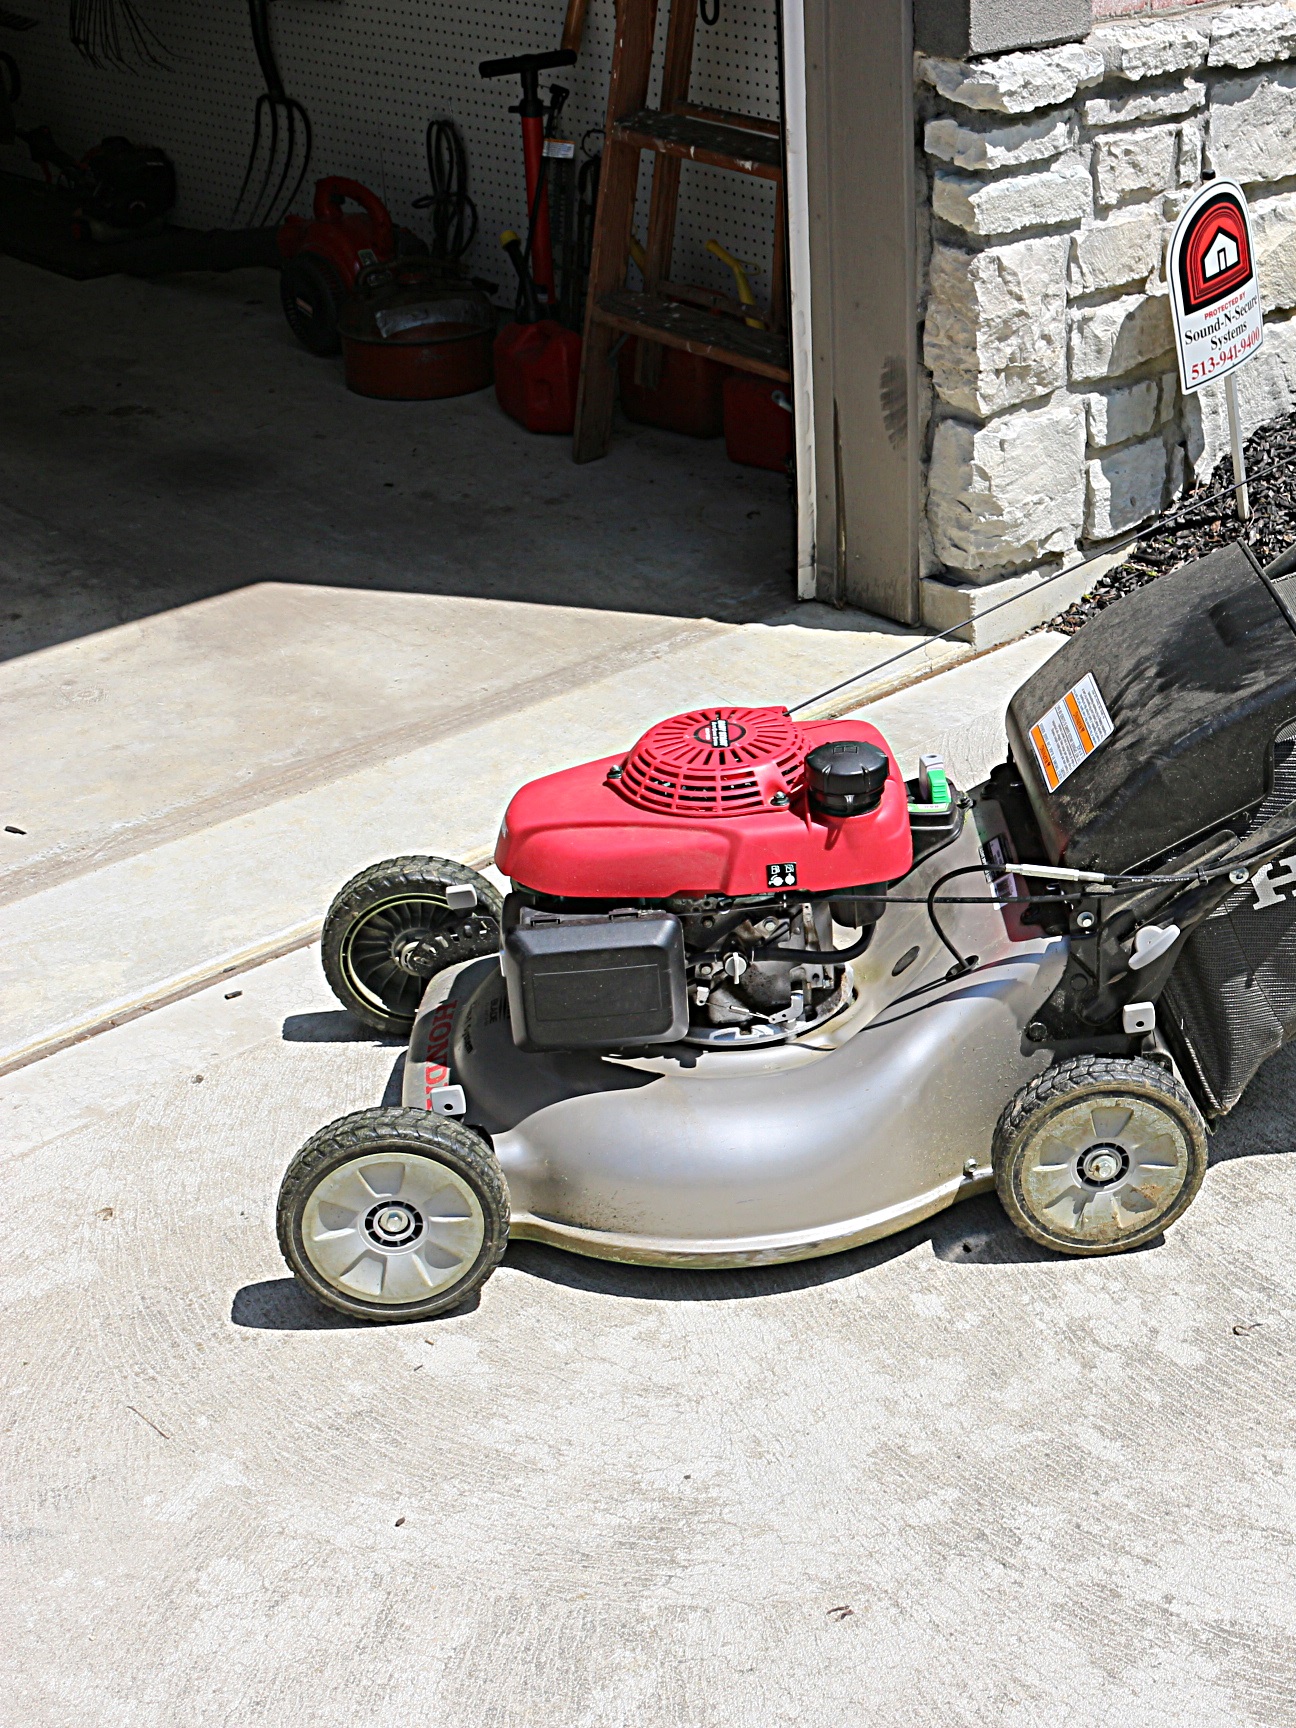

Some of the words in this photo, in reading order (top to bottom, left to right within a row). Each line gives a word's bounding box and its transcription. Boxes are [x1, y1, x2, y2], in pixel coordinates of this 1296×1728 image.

[1184, 295, 1258, 345] Sound-N-Secure
[1204, 296, 1239, 320] PROTECTED
[1239, 291, 1247, 302] BY
[1191, 327, 1261, 381] 513-941-9400
[1210, 321, 1248, 351] Systems
